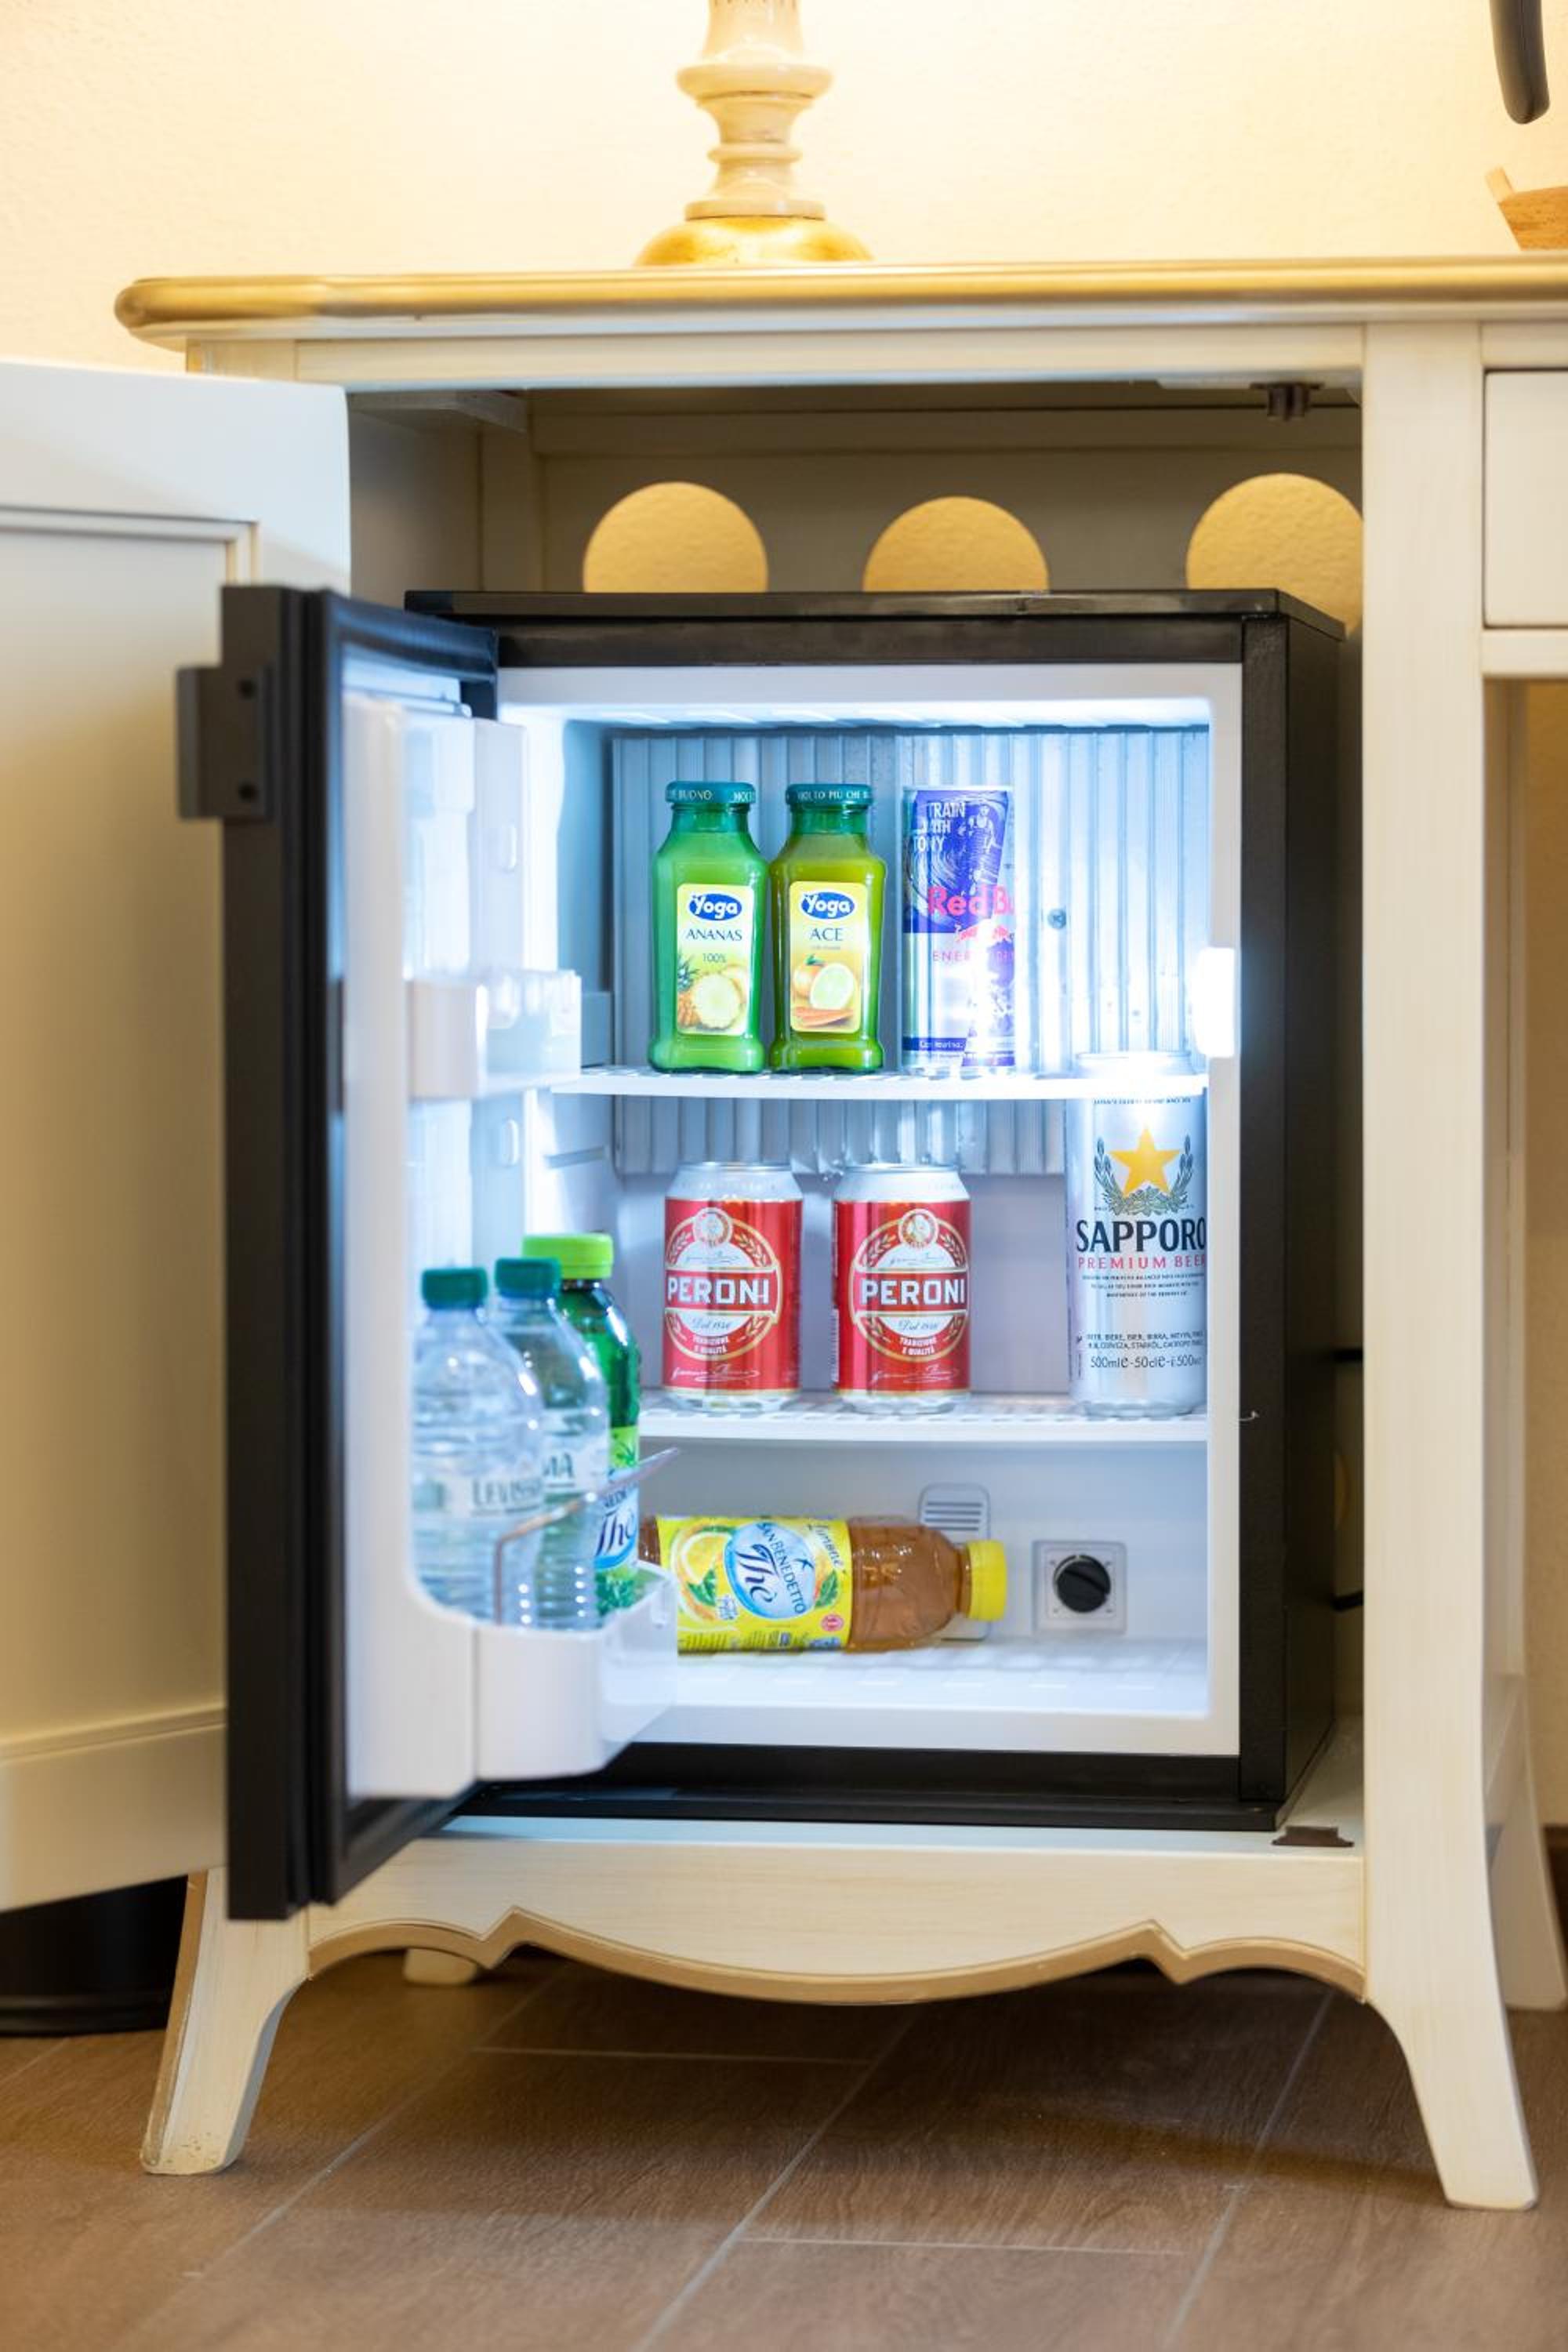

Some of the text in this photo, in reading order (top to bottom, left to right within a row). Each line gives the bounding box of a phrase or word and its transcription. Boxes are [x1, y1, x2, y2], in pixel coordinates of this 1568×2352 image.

[928, 802, 966, 818] TRAIN
[691, 893, 738, 920] Yoga
[803, 893, 851, 918] Yoga
[928, 884, 988, 916] Red
[686, 928, 742, 942] ANANAS
[809, 927, 844, 942] ACE
[1076, 1217, 1206, 1253] SAPPORO
[1078, 1257, 1167, 1269] PREMIUM
[666, 1276, 770, 1305] PERONI
[862, 1279, 966, 1306] PERONI
[770, 1541, 808, 1614] BENEDETTO
